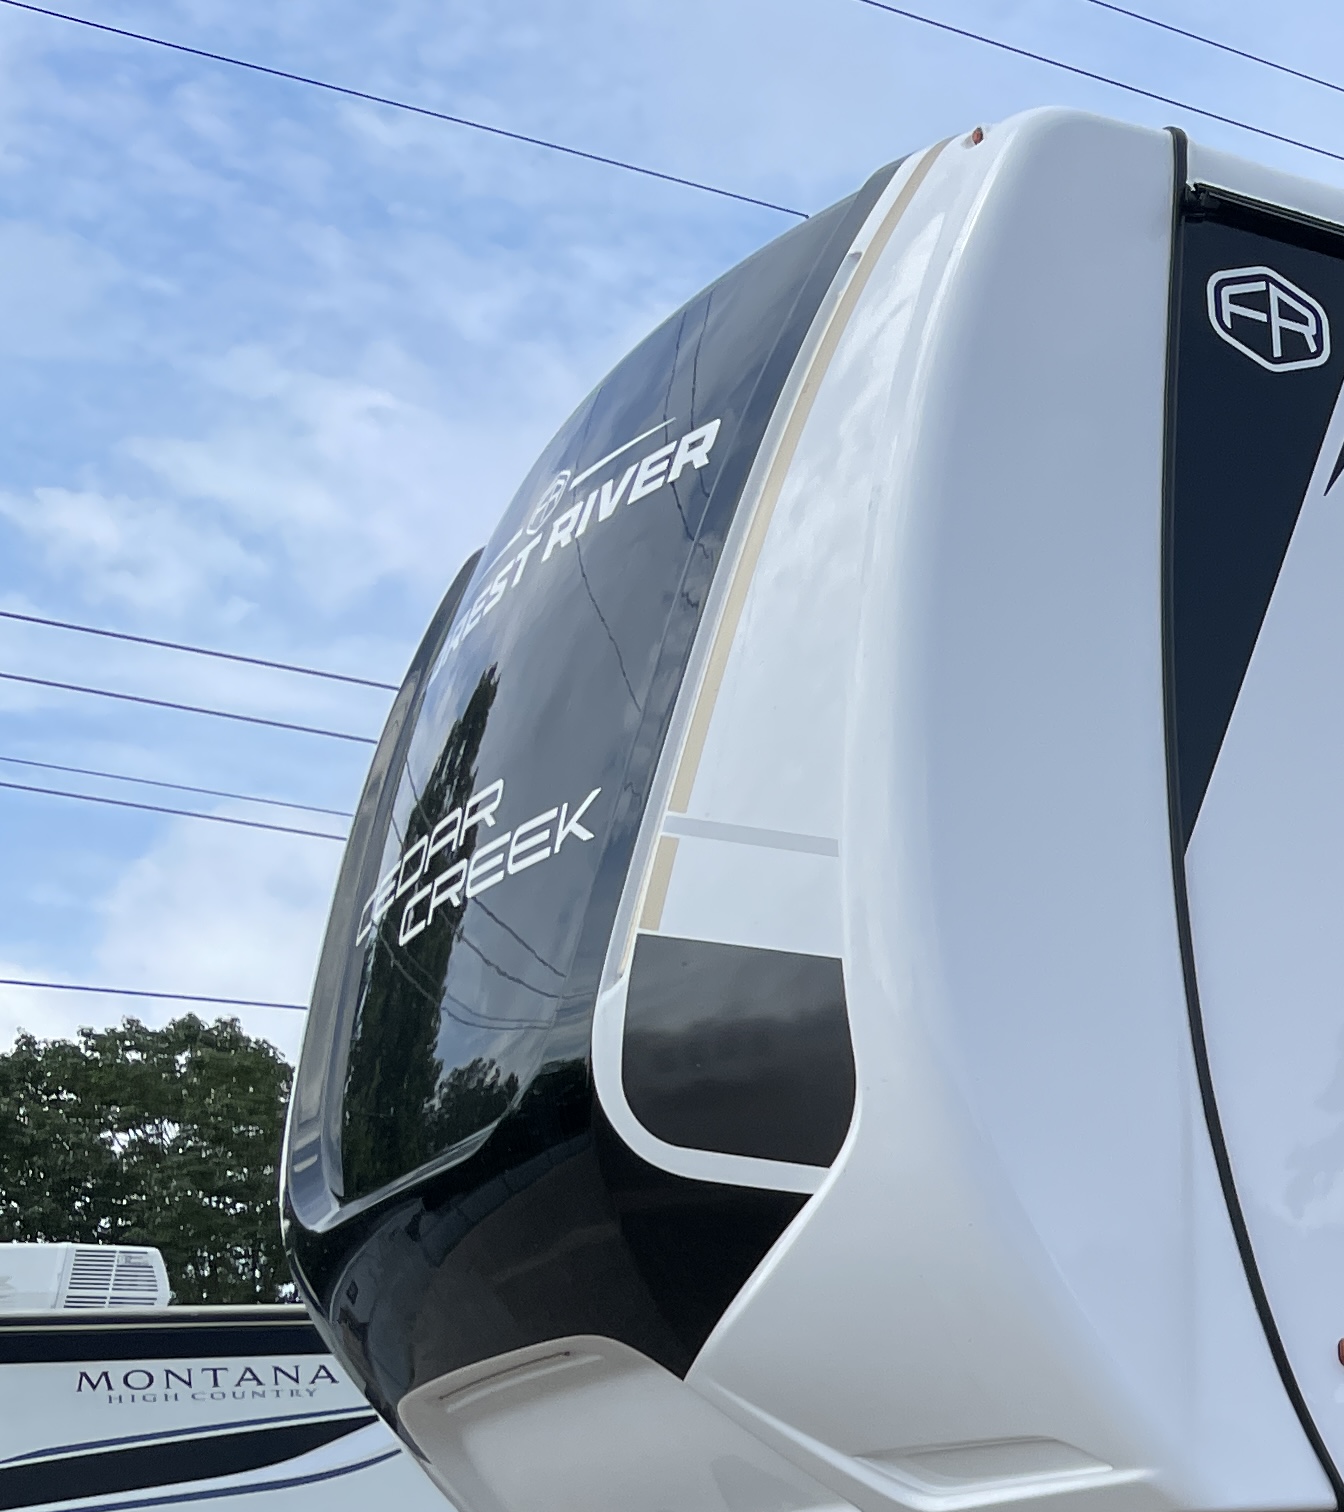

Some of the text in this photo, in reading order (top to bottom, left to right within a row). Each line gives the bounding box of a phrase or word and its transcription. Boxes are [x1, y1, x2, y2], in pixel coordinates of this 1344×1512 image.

[427, 418, 721, 688] REST RIVER
[356, 778, 504, 947] CEDAR
[399, 787, 602, 947] CREEK
[76, 1364, 340, 1393] MONTANA
[107, 1387, 318, 1404] HIGH COUNTRY
